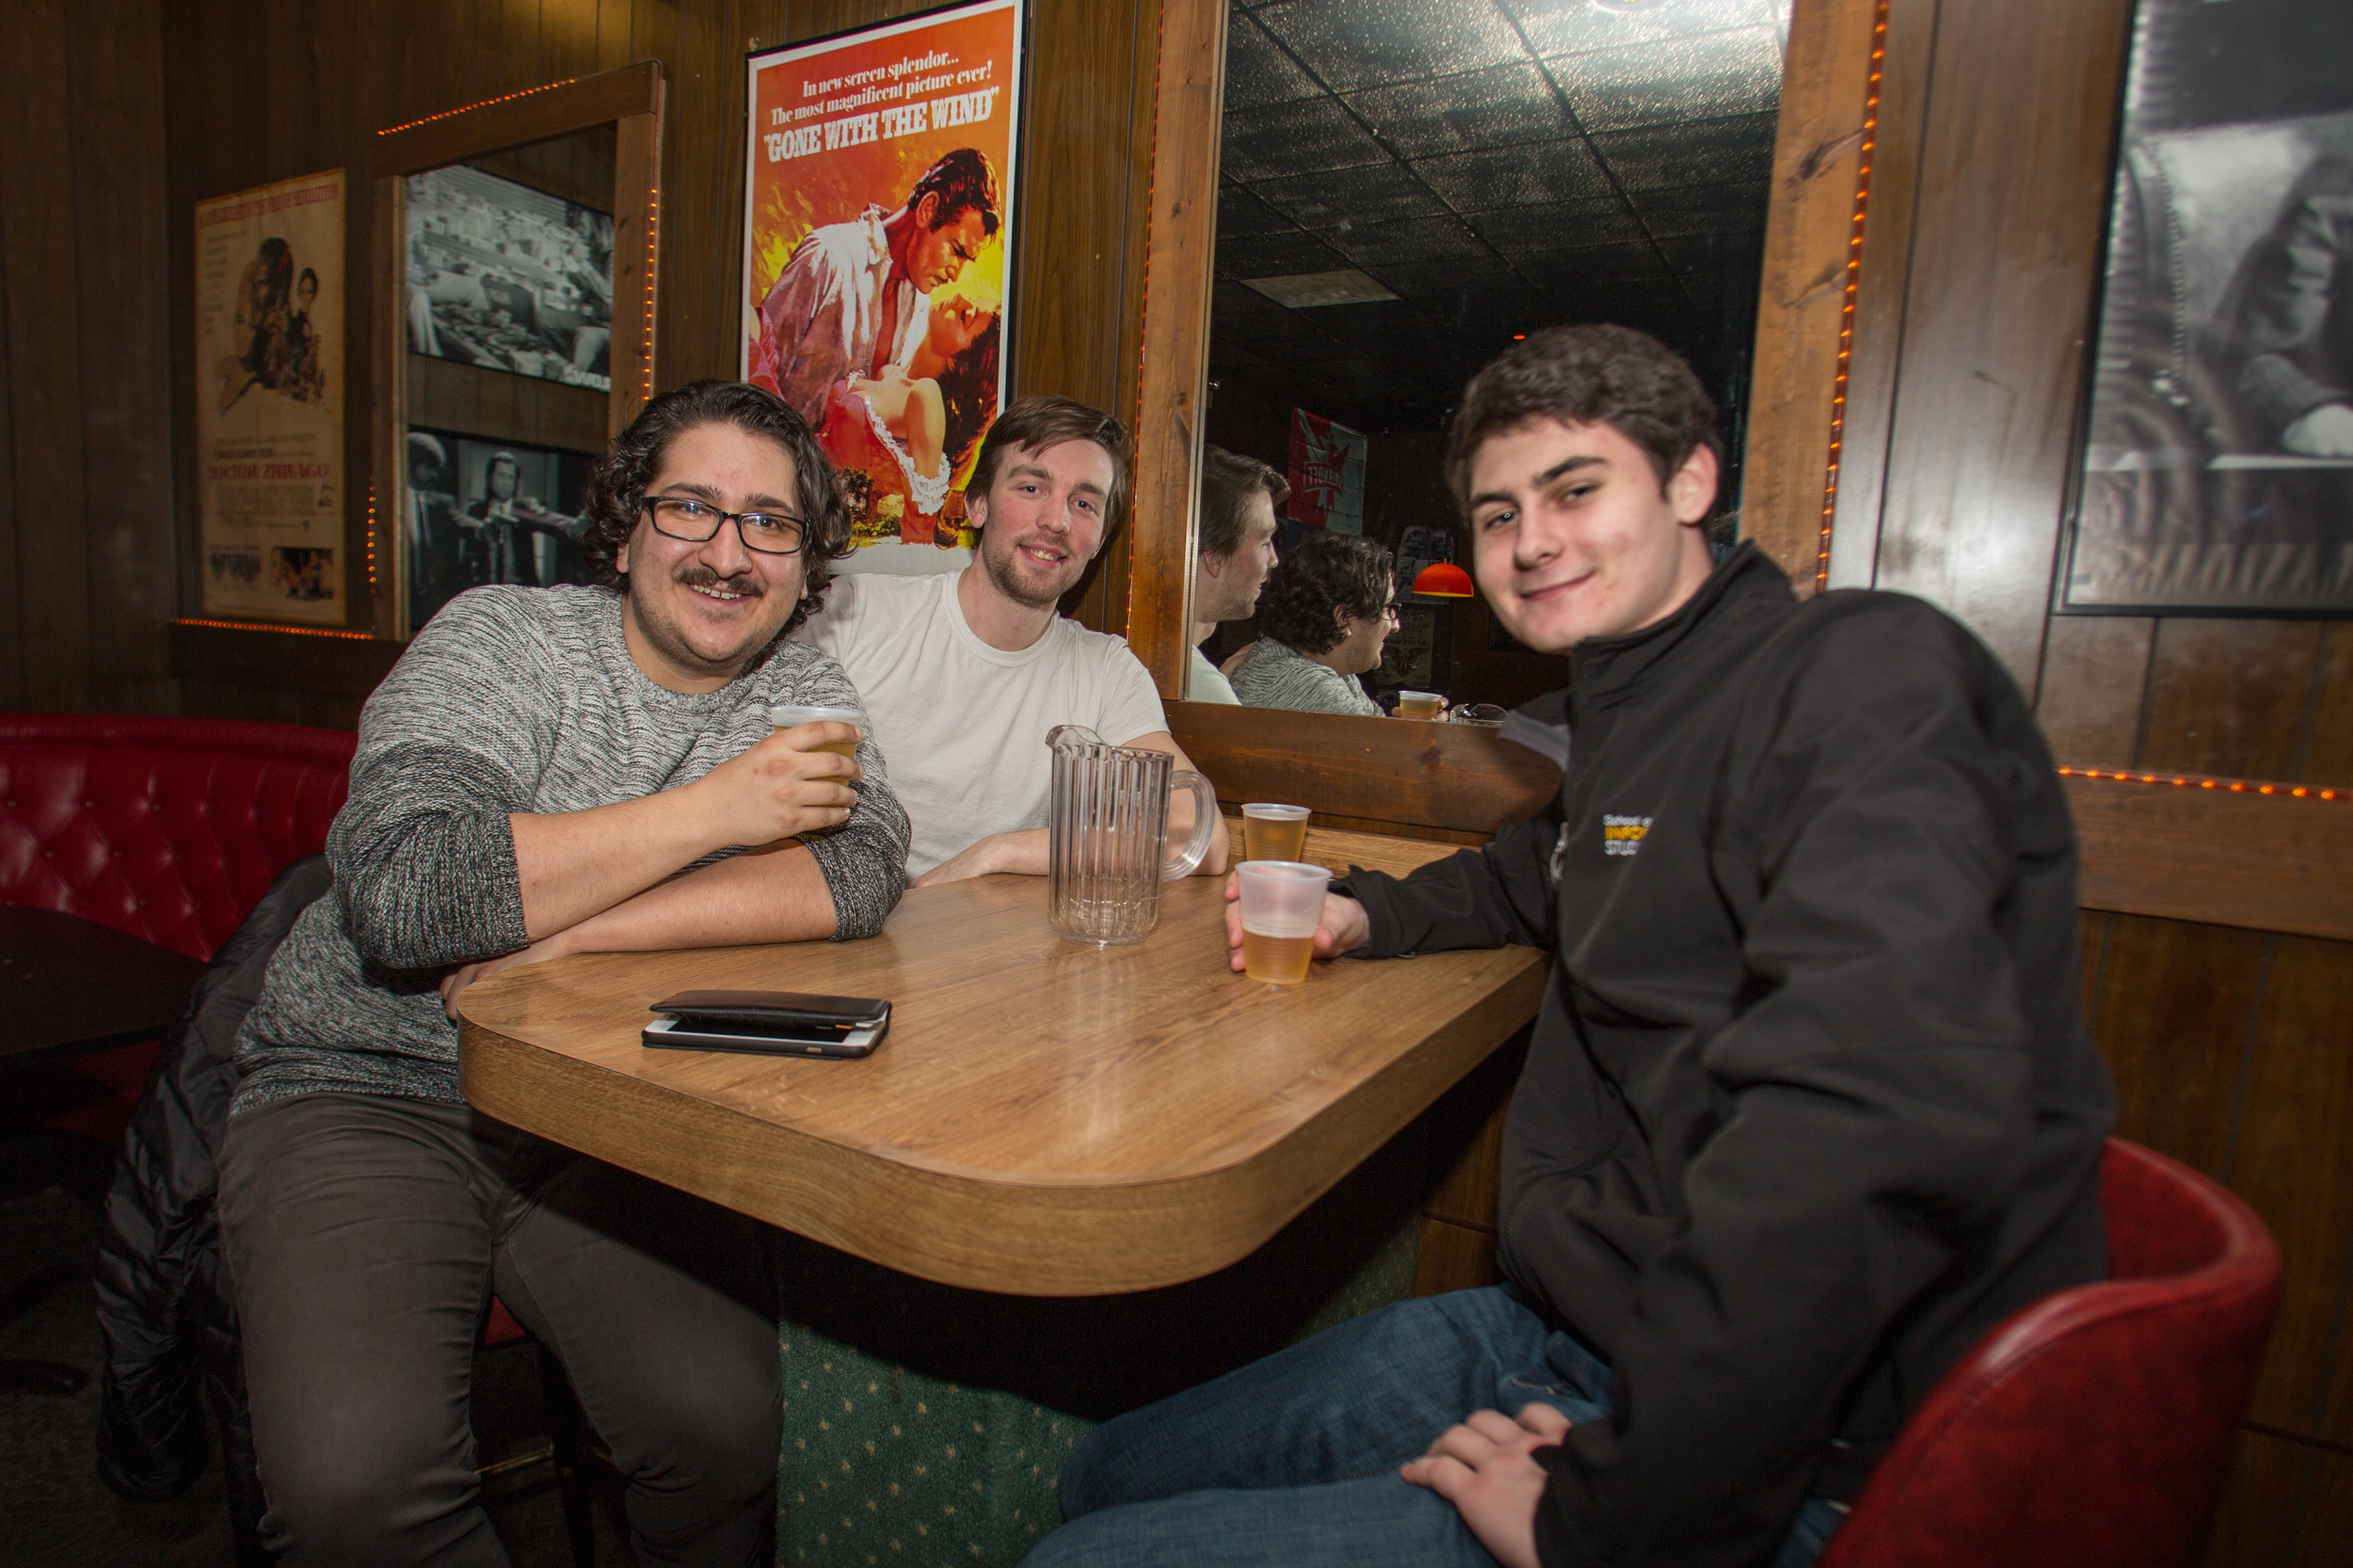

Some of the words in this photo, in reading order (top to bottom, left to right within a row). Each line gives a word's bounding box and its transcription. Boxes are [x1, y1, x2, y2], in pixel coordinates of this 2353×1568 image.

[771, 107, 793, 126] The
[794, 101, 824, 120] most
[826, 86, 904, 114] magnificent
[905, 71, 955, 100] picture
[956, 60, 993, 85] ever!
[803, 80, 817, 97] In
[819, 77, 843, 94] new
[844, 66, 886, 87] screen
[888, 50, 959, 82] splendor...
[763, 124, 822, 163] "GONE
[824, 112, 879, 151] WITH
[881, 101, 928, 139] THE
[930, 86, 1000, 131] WIND"
